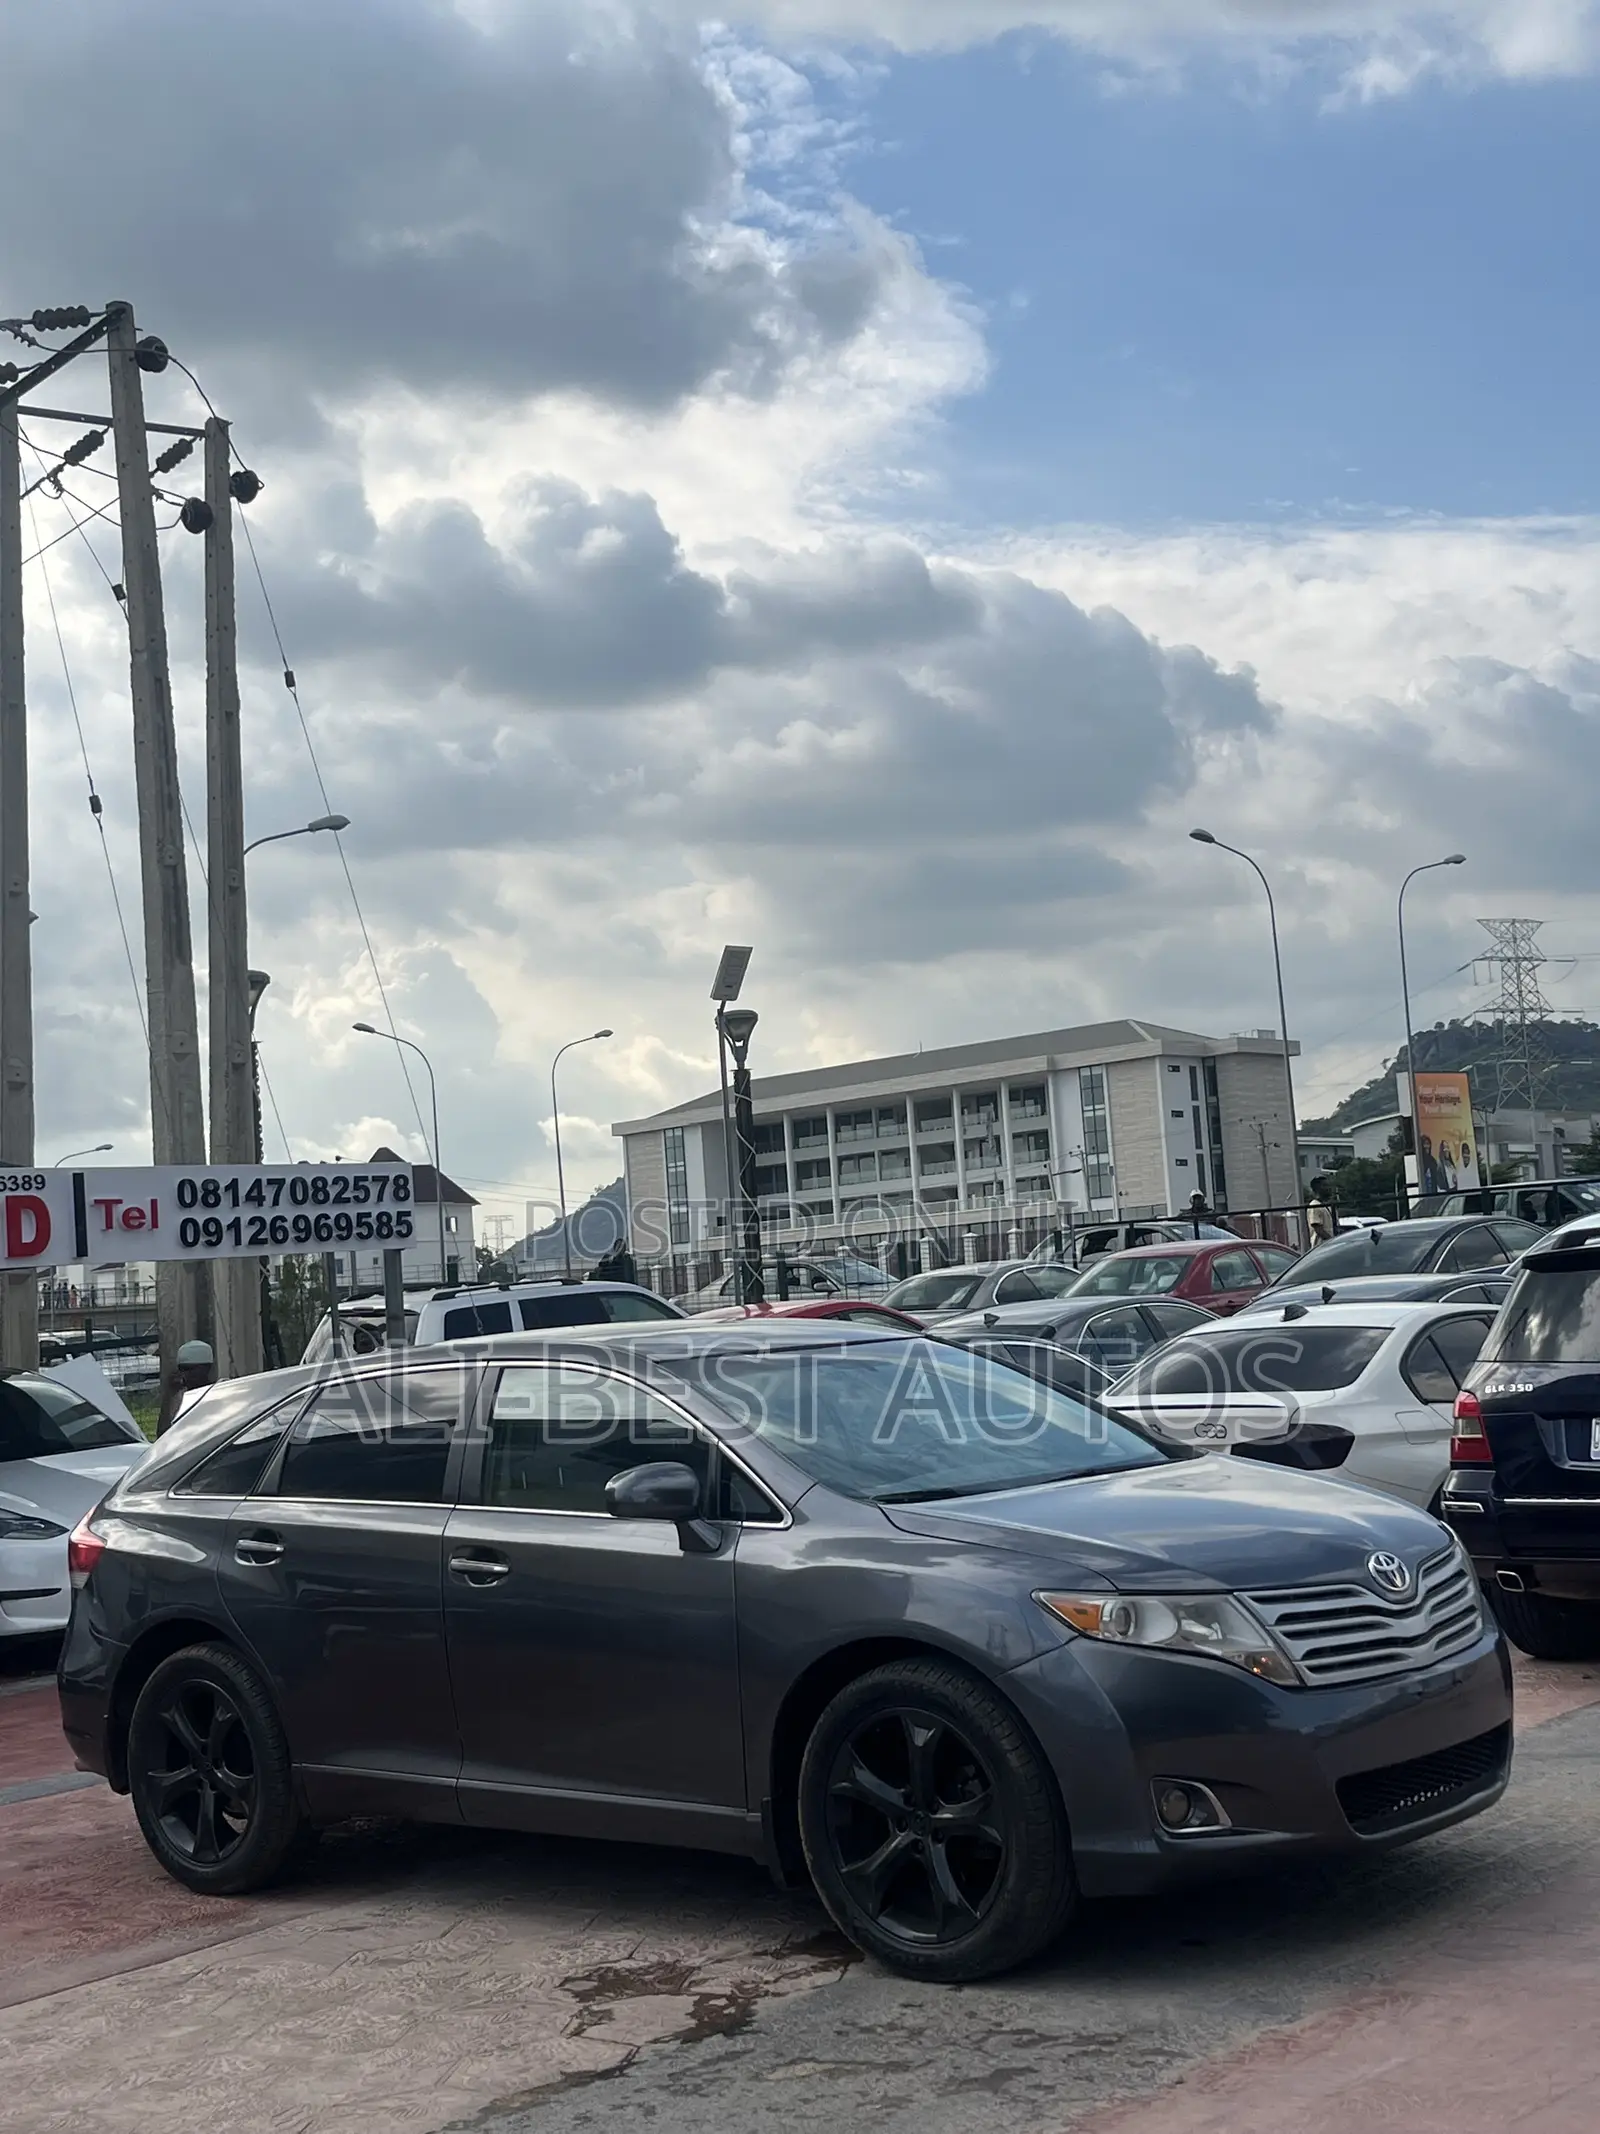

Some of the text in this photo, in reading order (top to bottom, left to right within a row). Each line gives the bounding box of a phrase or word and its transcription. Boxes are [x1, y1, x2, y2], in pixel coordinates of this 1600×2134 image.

[177, 1173, 411, 1209] 08147082578
[5, 1195, 51, 1258] D
[93, 1198, 160, 1231] Tel
[179, 1210, 413, 1248] 09126969585
[1484, 1383, 1534, 1394] GLK 350
